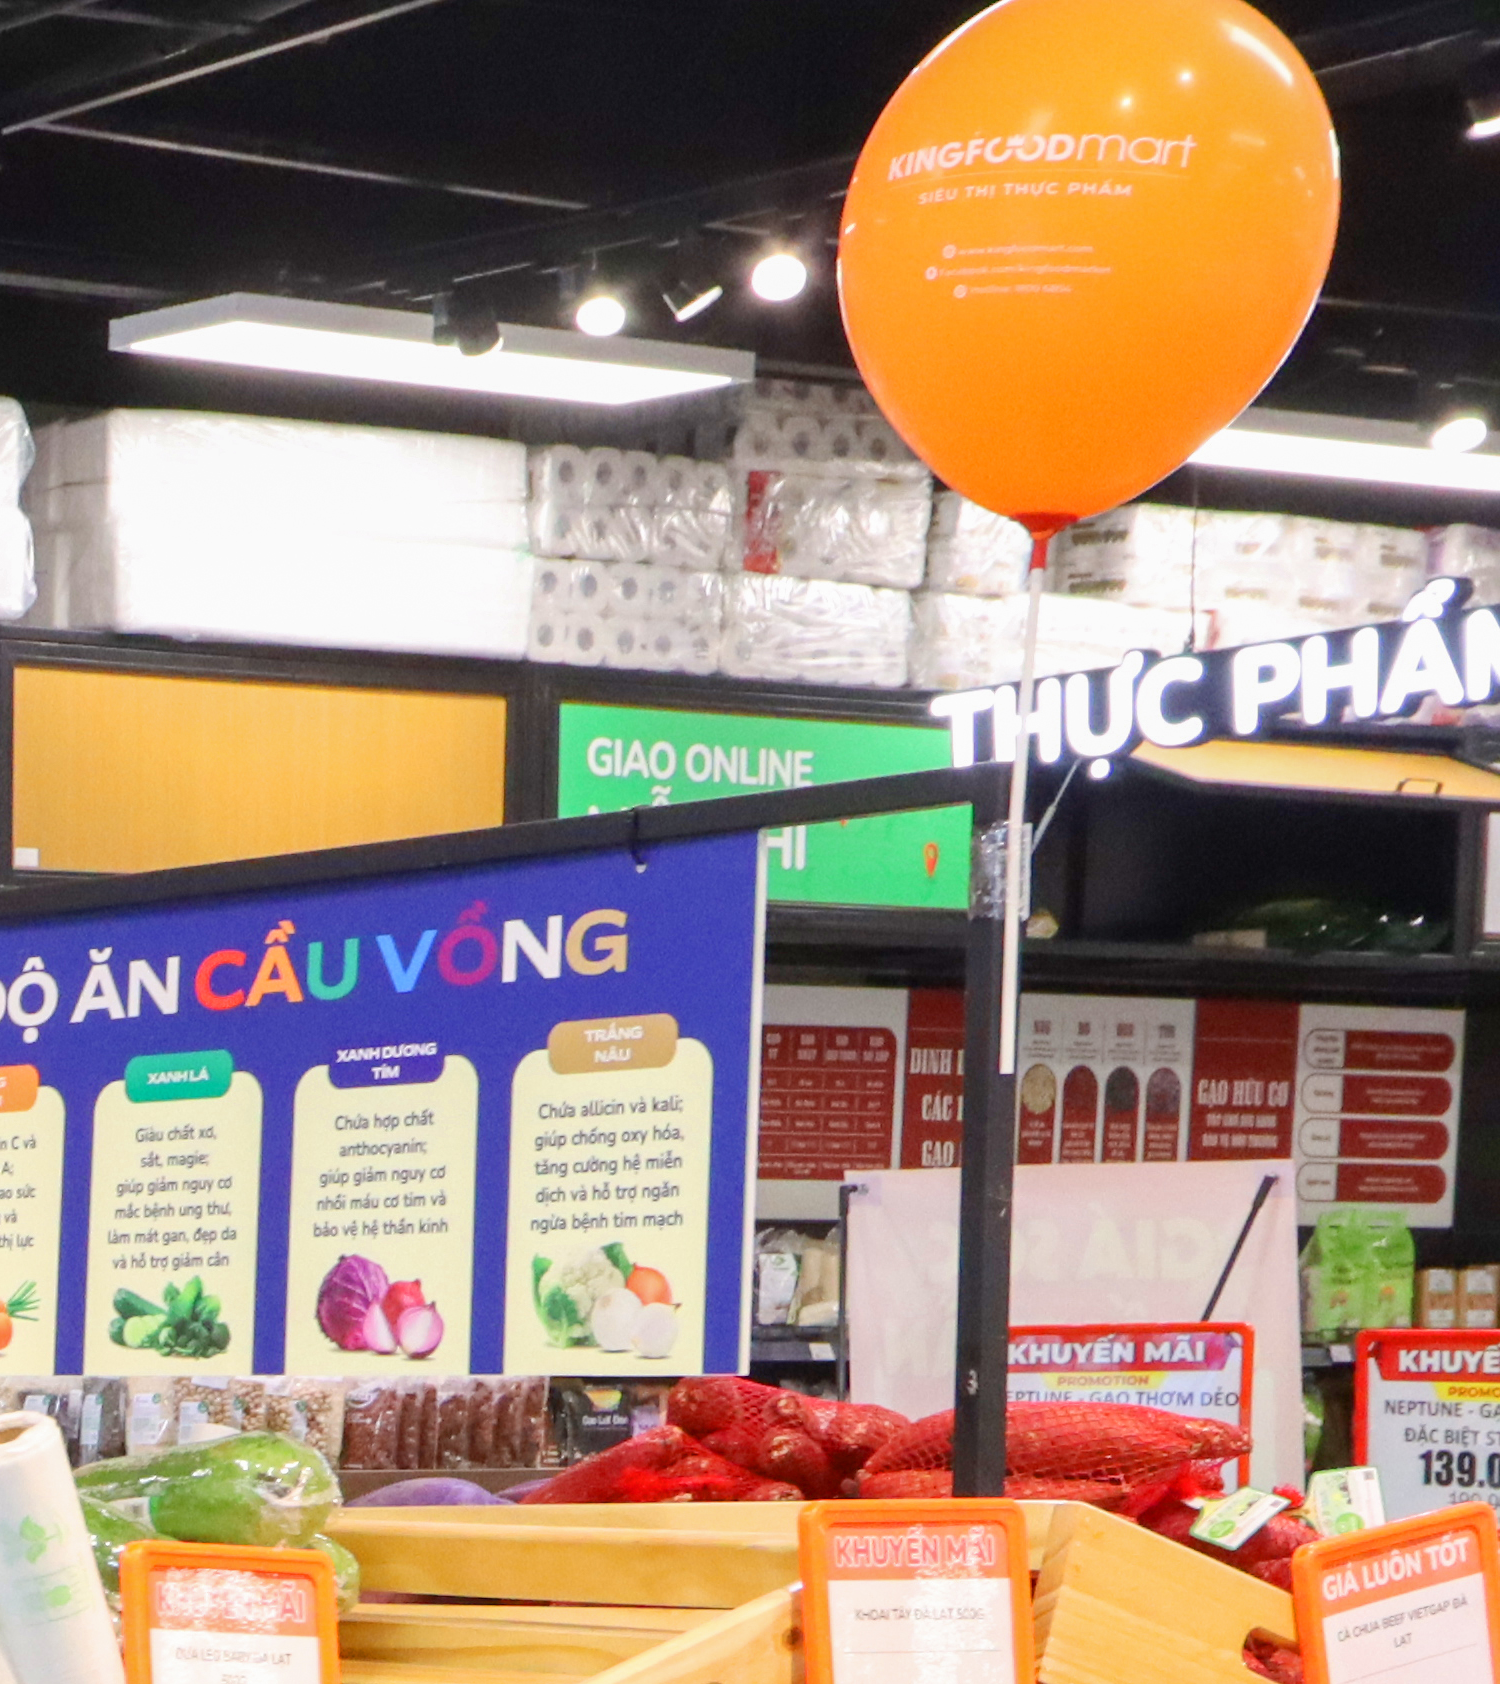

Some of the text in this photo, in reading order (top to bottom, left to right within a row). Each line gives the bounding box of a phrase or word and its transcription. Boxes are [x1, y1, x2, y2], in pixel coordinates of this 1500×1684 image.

[929, 650, 1204, 780] THỰC
[586, 737, 815, 787] GIAO ONLINE
[69, 946, 181, 1024] ĂN
[194, 919, 360, 1011] CẦU
[375, 899, 628, 993] VỒNG
[584, 1021, 644, 1043] TRẮNG
[336, 1042, 438, 1063] XANH DƯƠNG
[594, 1046, 632, 1063] NÂU
[909, 1047, 953, 1075] DINH
[147, 1069, 189, 1086] XANH
[371, 1063, 400, 1080] TÍM
[538, 1094, 684, 1120] Chứa allicin và kali;
[921, 1089, 951, 1121] CÁC
[535, 1122, 685, 1151] giúp chống oxy hóa,
[535, 1149, 683, 1178] tăng cường hệ miễn
[536, 1181, 680, 1207] dịch và hỗ trợ ngăn
[531, 1209, 684, 1235] ngừa bệnh tim mạch
[1008, 1334, 1206, 1366] KHUYẾN MÃI
[1057, 1373, 1150, 1388] PROMOTION
[1136, 1386, 1240, 1407] THƠM DẺO
[1384, 1401, 1463, 1418] NEPTUNE
[1404, 1424, 1481, 1448] ĐẶC BIỆT
[834, 1525, 939, 1568] KHUYẾN
[1321, 1532, 1471, 1602] GIÁ LUÔN TỐT
[854, 1608, 890, 1622] KHOAI
[1381, 1612, 1406, 1630] BEEF
